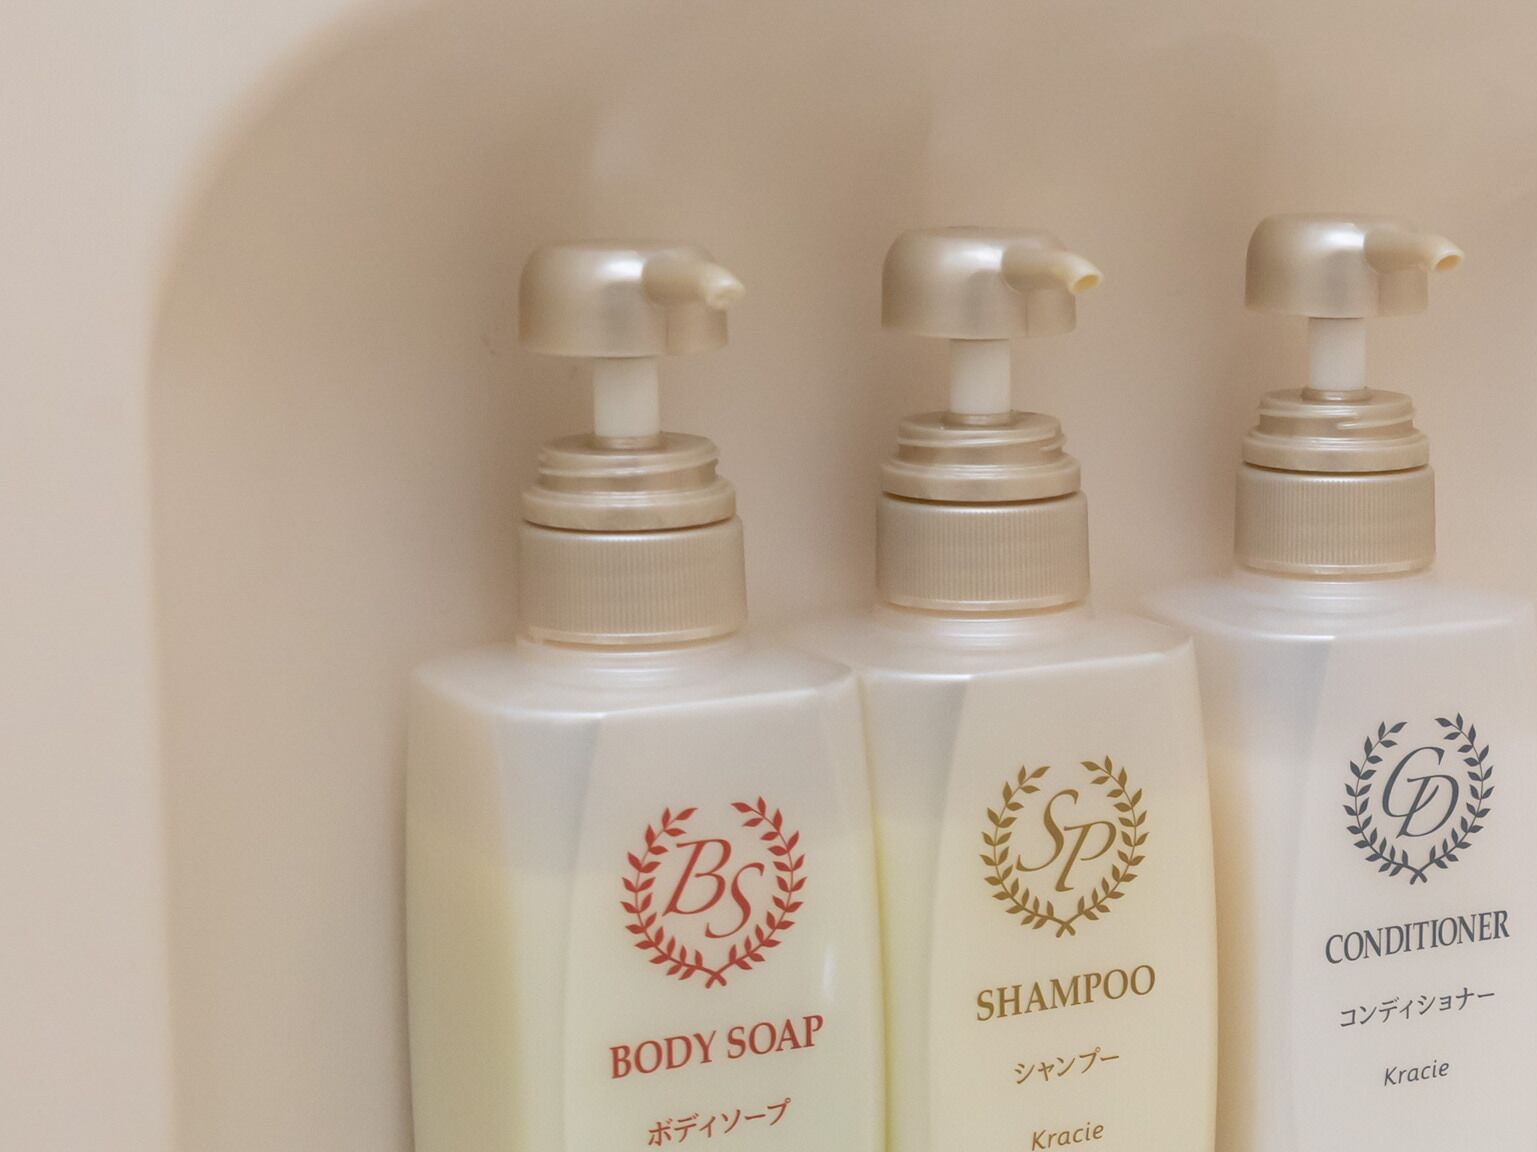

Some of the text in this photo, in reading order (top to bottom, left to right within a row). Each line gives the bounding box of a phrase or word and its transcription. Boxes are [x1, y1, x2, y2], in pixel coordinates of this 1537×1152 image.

[661, 837, 765, 939] BS
[1326, 911, 1510, 965] CONDITIONER
[977, 965, 1156, 1022] SHAMPOO
[1339, 987, 1495, 1028] コンディショナー
[610, 1015, 825, 1080] BODY SOAP
[1014, 1047, 1120, 1085] シャンプー
[1384, 1060, 1450, 1087] Kracie
[647, 1098, 792, 1147] ボディソープ
[1031, 1122, 1104, 1152] Kracie
